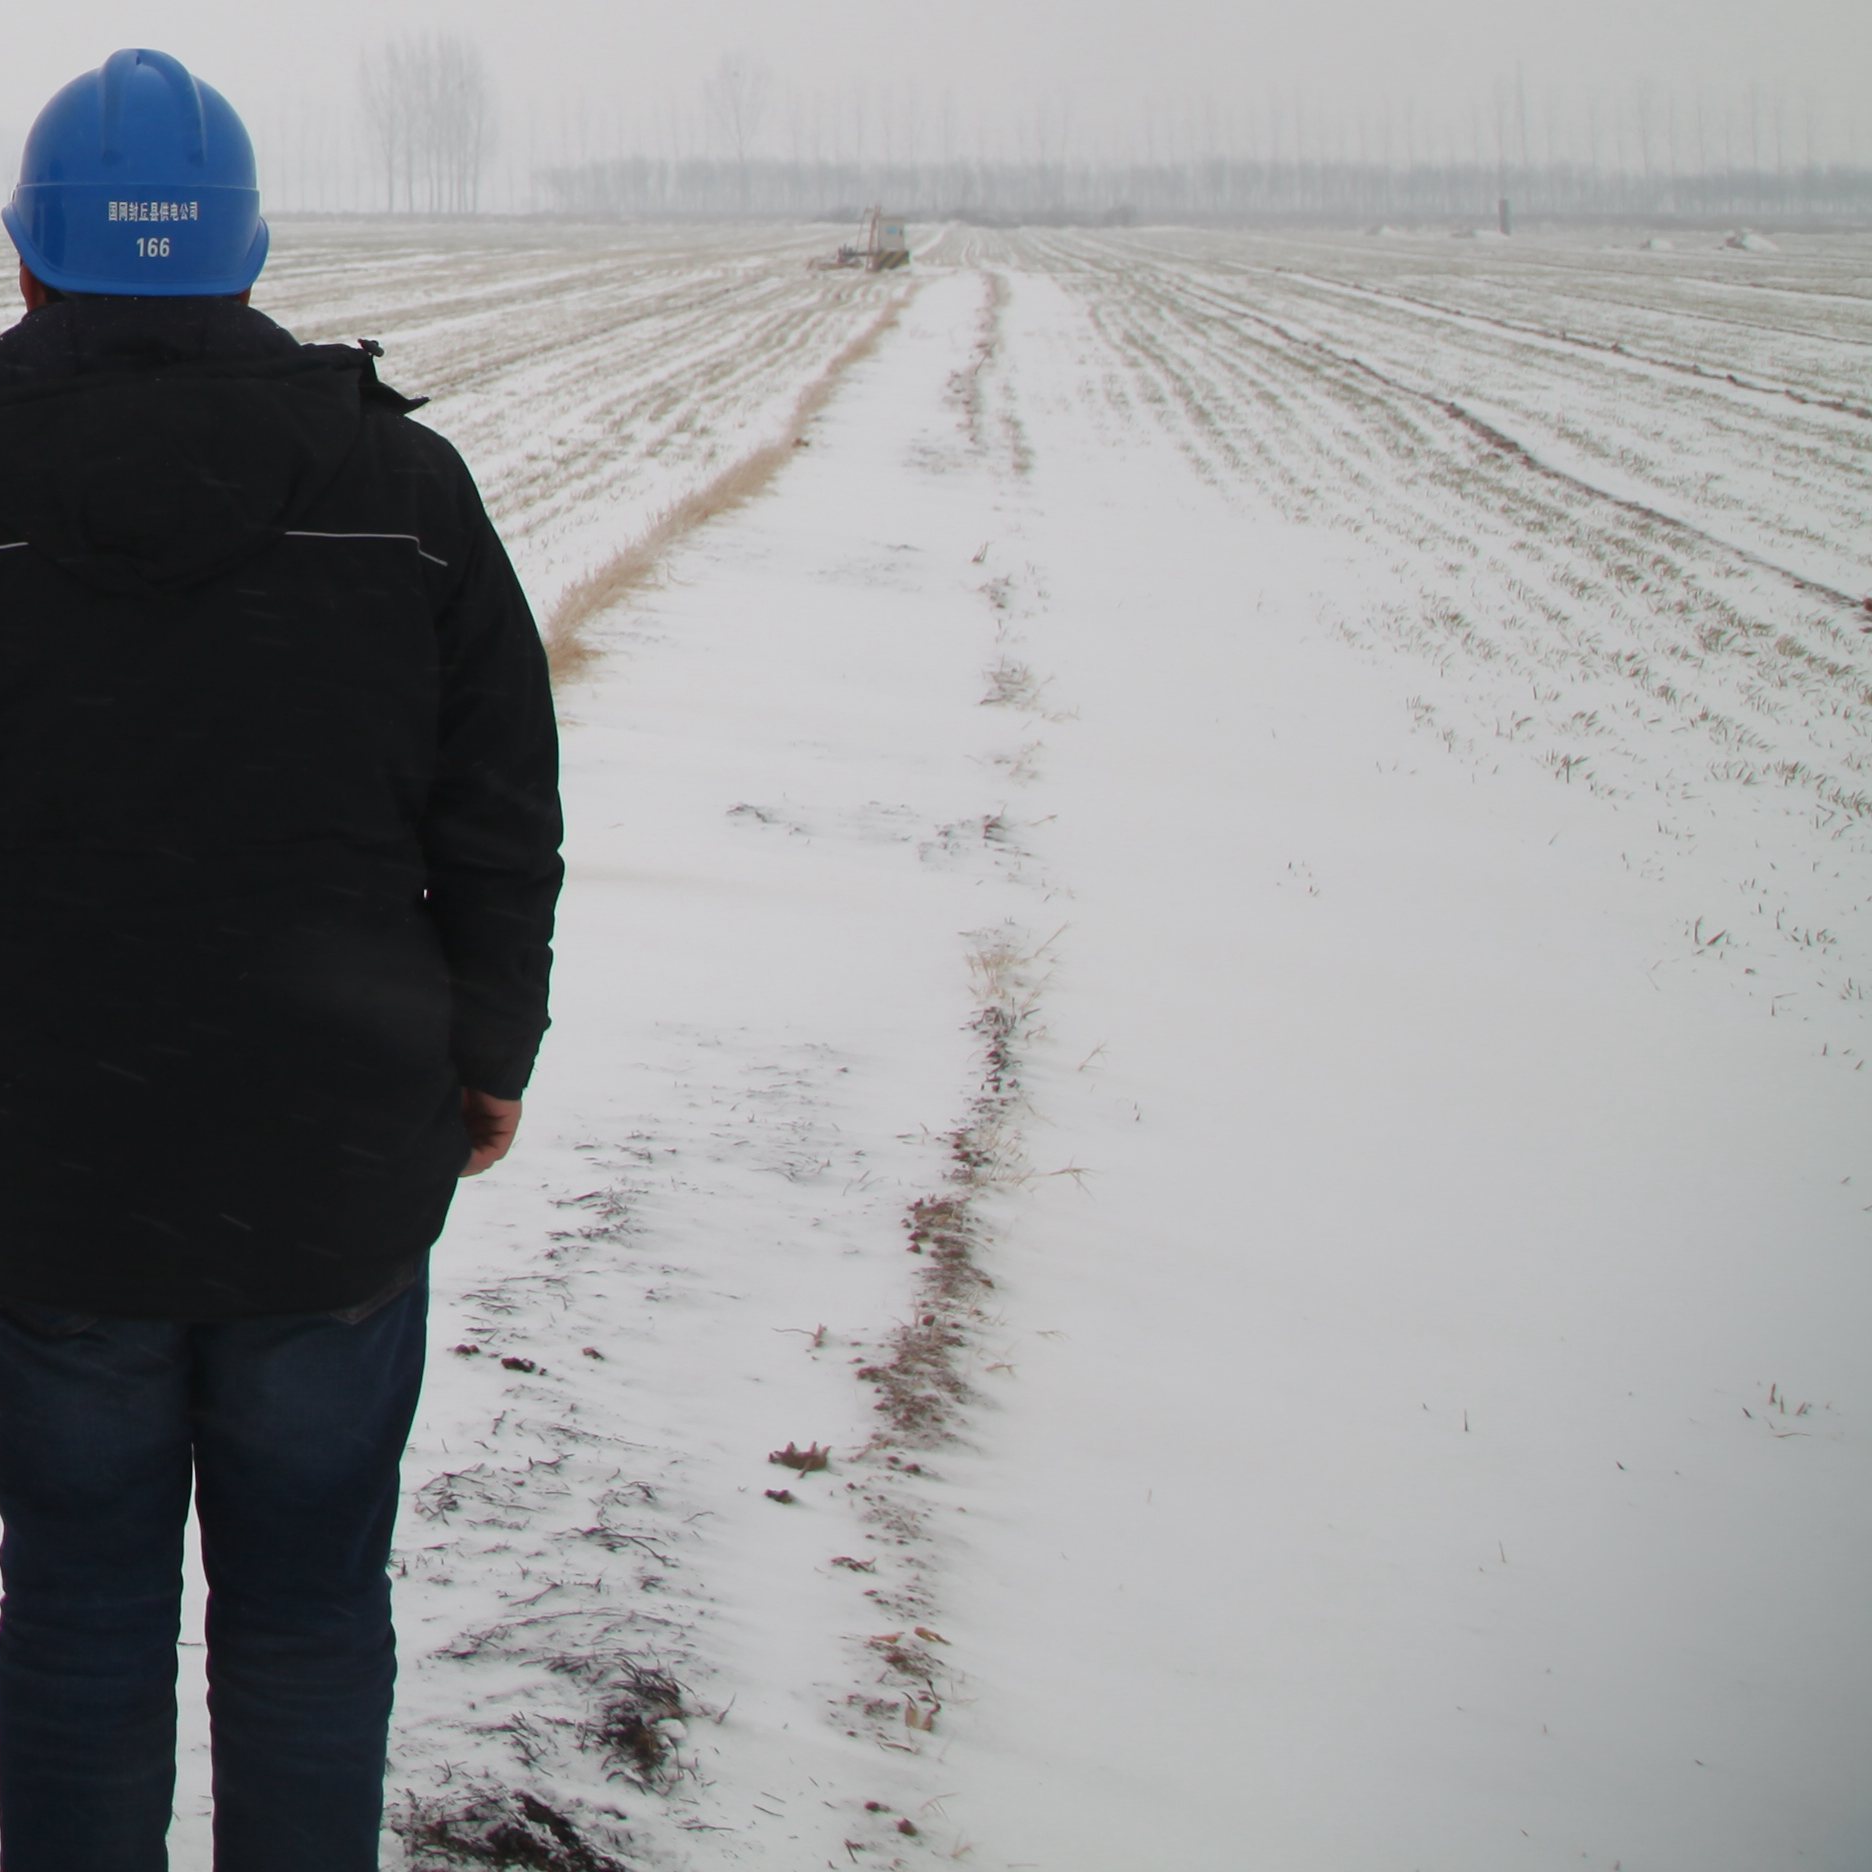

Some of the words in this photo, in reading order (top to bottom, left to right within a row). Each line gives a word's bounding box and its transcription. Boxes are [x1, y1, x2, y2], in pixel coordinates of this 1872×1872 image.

[108, 201, 198, 221] 国网封丘县供电公司
[136, 237, 170, 257] 166
